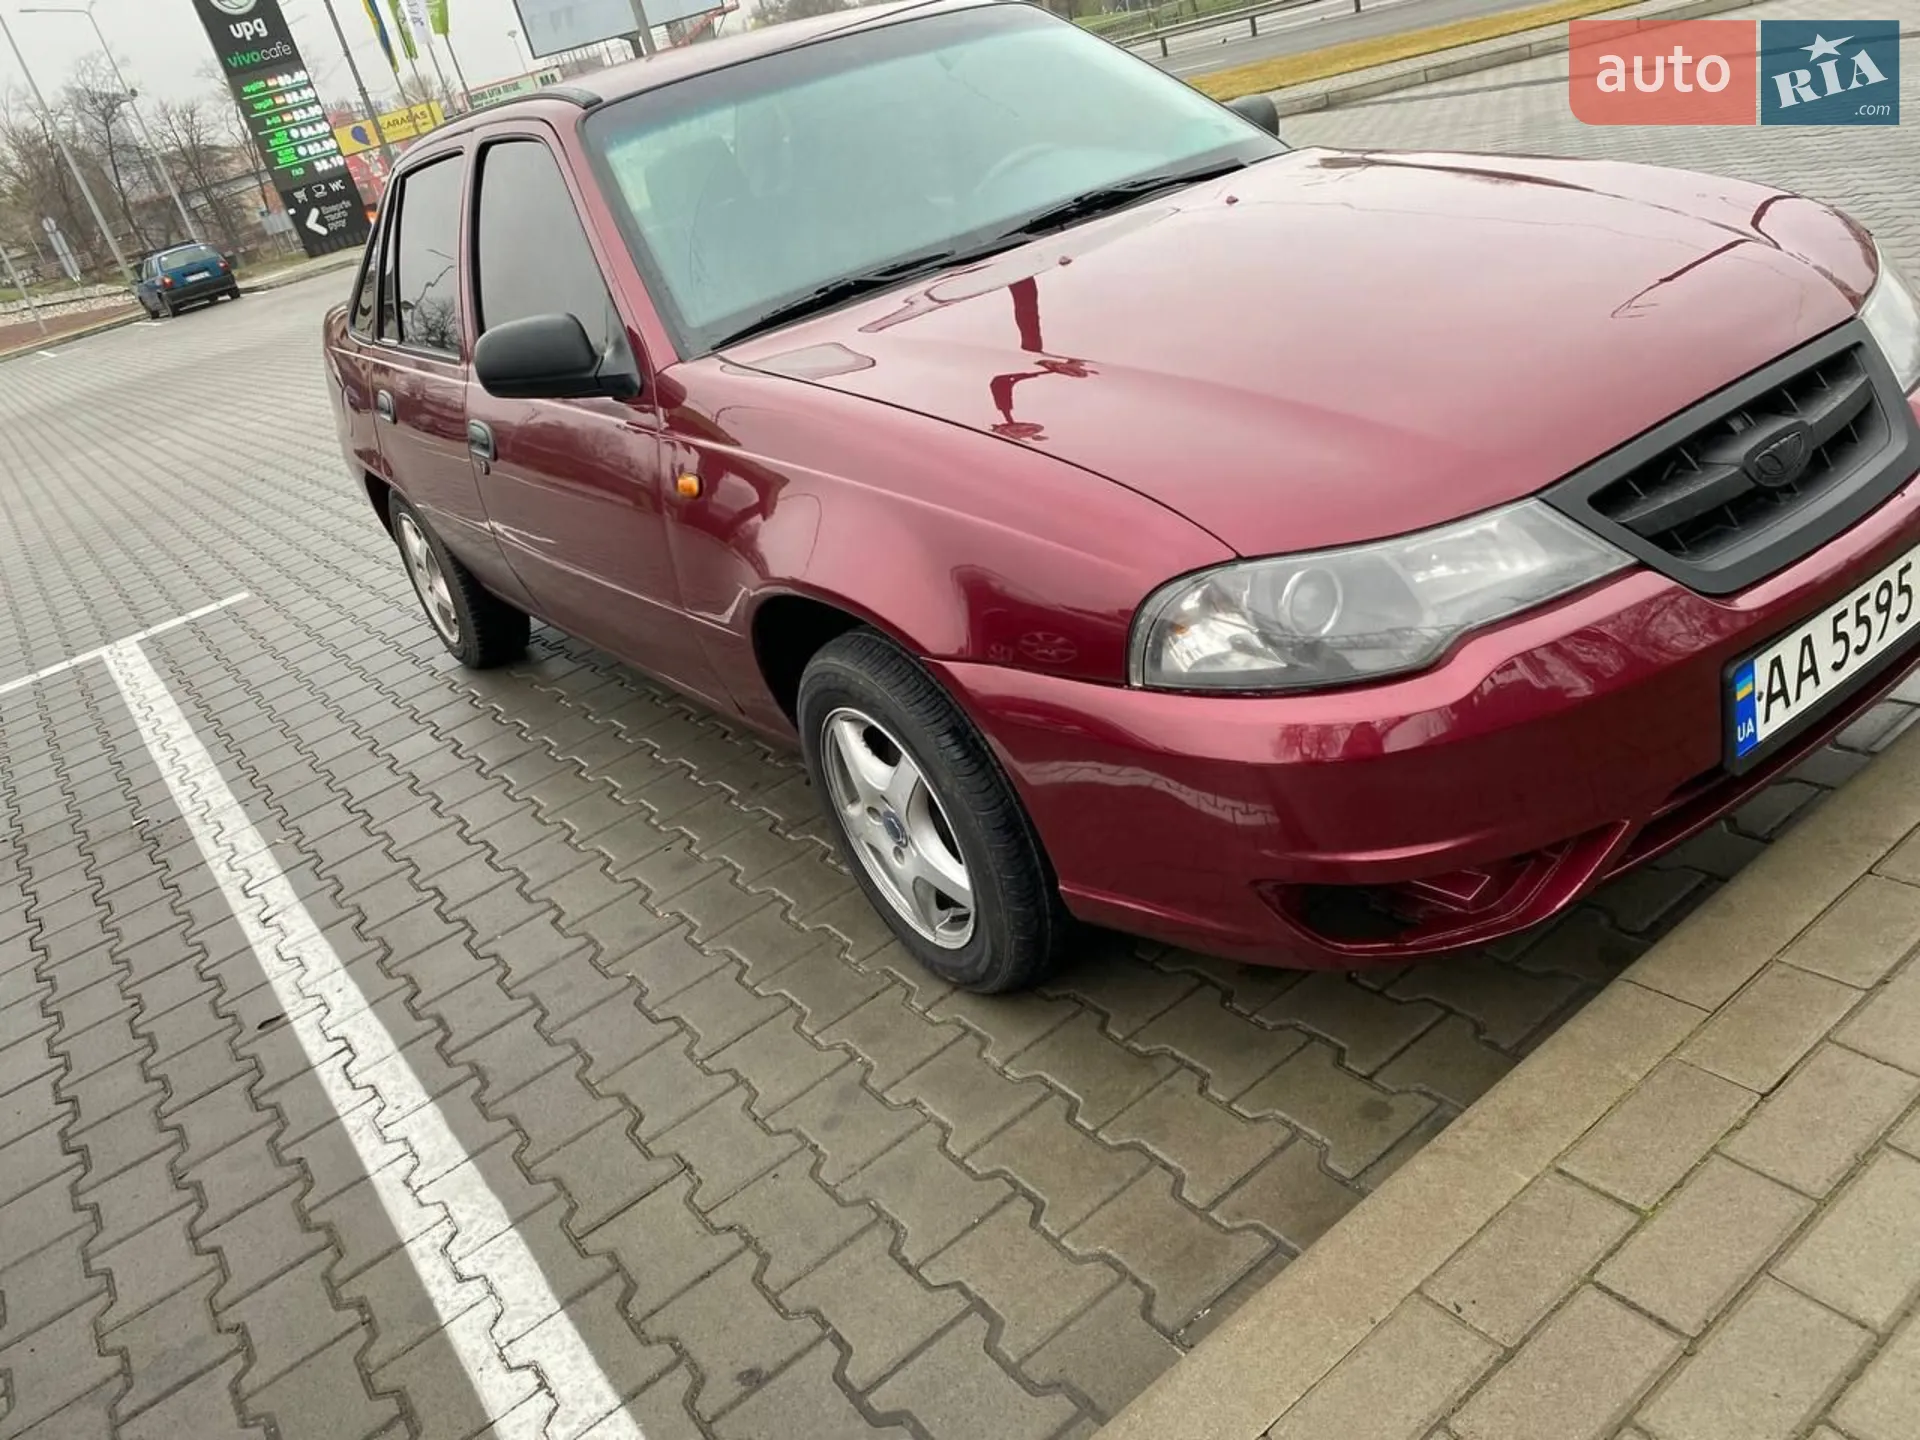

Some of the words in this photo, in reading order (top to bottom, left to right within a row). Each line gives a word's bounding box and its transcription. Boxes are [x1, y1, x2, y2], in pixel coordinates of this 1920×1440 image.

[229, 18, 268, 41] upg
[328, 180, 345, 192] WC
[1763, 633, 1821, 725] AA
[1831, 561, 1913, 673] 5595
[1736, 717, 1755, 742] UA
